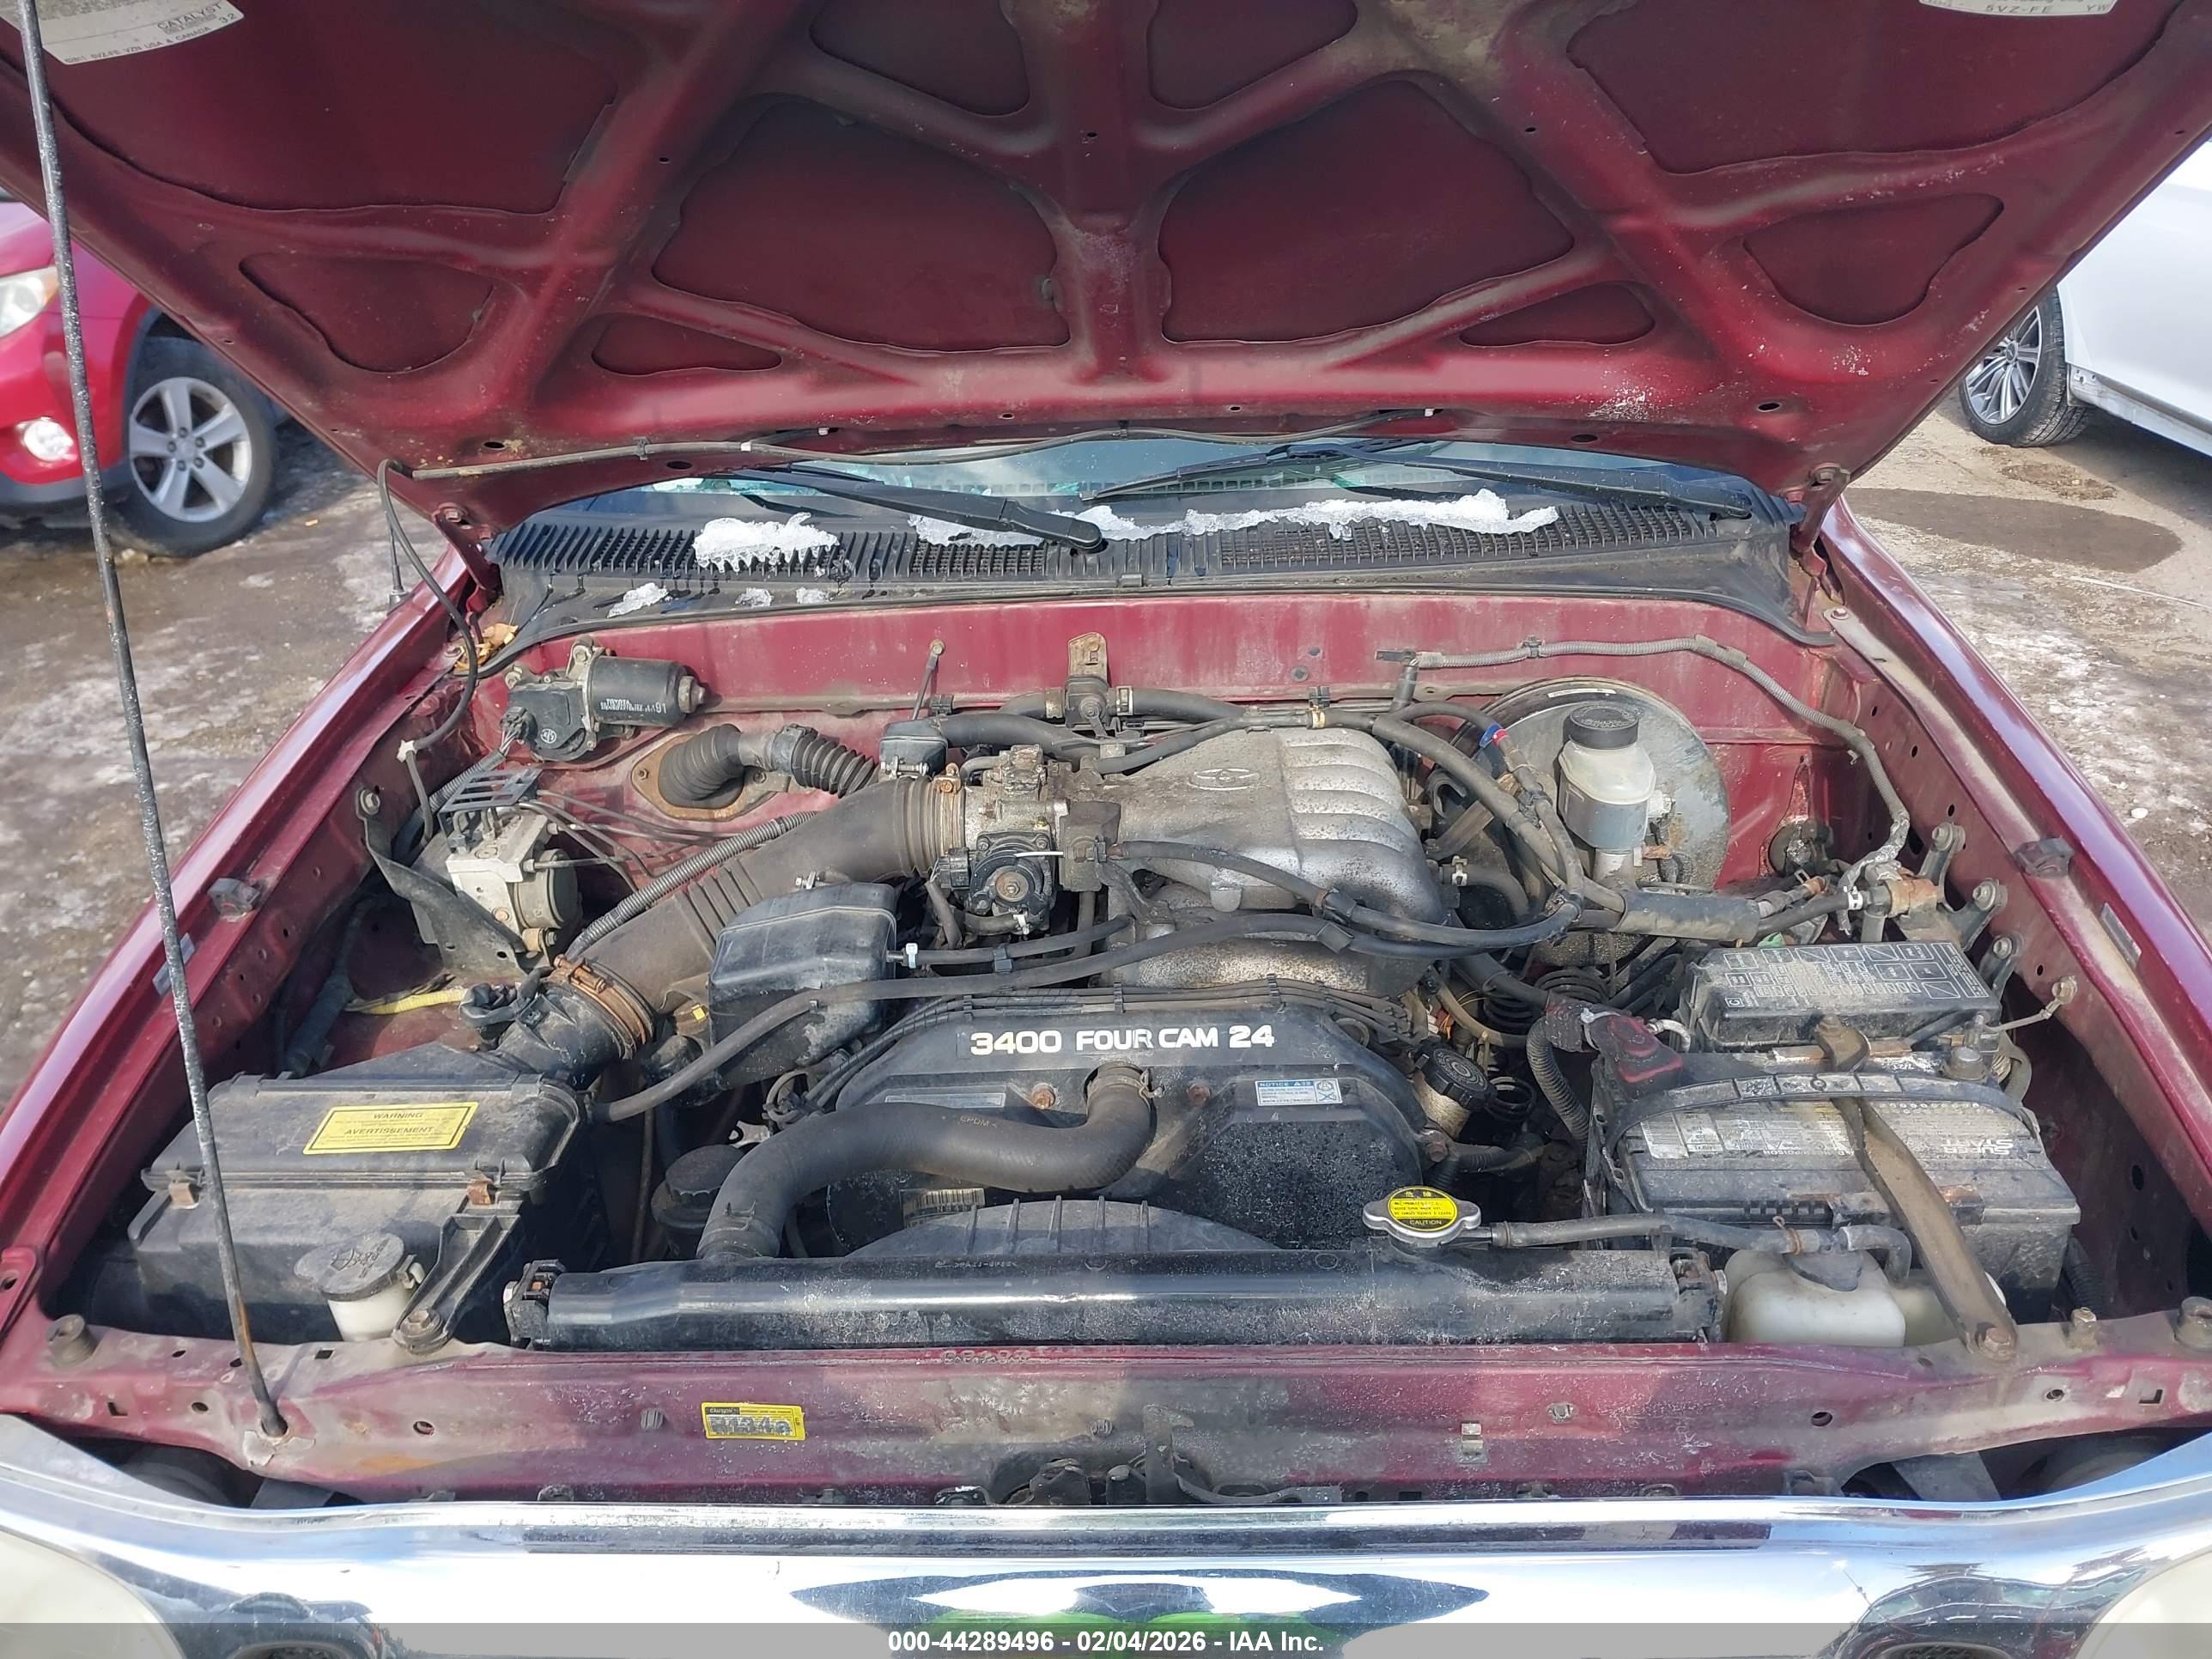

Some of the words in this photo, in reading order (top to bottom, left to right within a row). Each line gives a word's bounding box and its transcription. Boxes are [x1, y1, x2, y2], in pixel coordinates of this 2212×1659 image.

[157, 3, 223, 30] CATALYST
[218, 13, 237, 24] 32
[144, 40, 162, 49] USA
[175, 26, 211, 41] CANADA
[970, 1030, 1062, 1056] 3400
[1076, 1030, 1154, 1051] FOUR
[1158, 1027, 1219, 1049] CAM
[1228, 1024, 1275, 1048] 24
[344, 1126, 435, 1135] AVERTISSEMENT
[1941, 1139, 2014, 1148] START
[1943, 1146, 2010, 1155] SUPER
